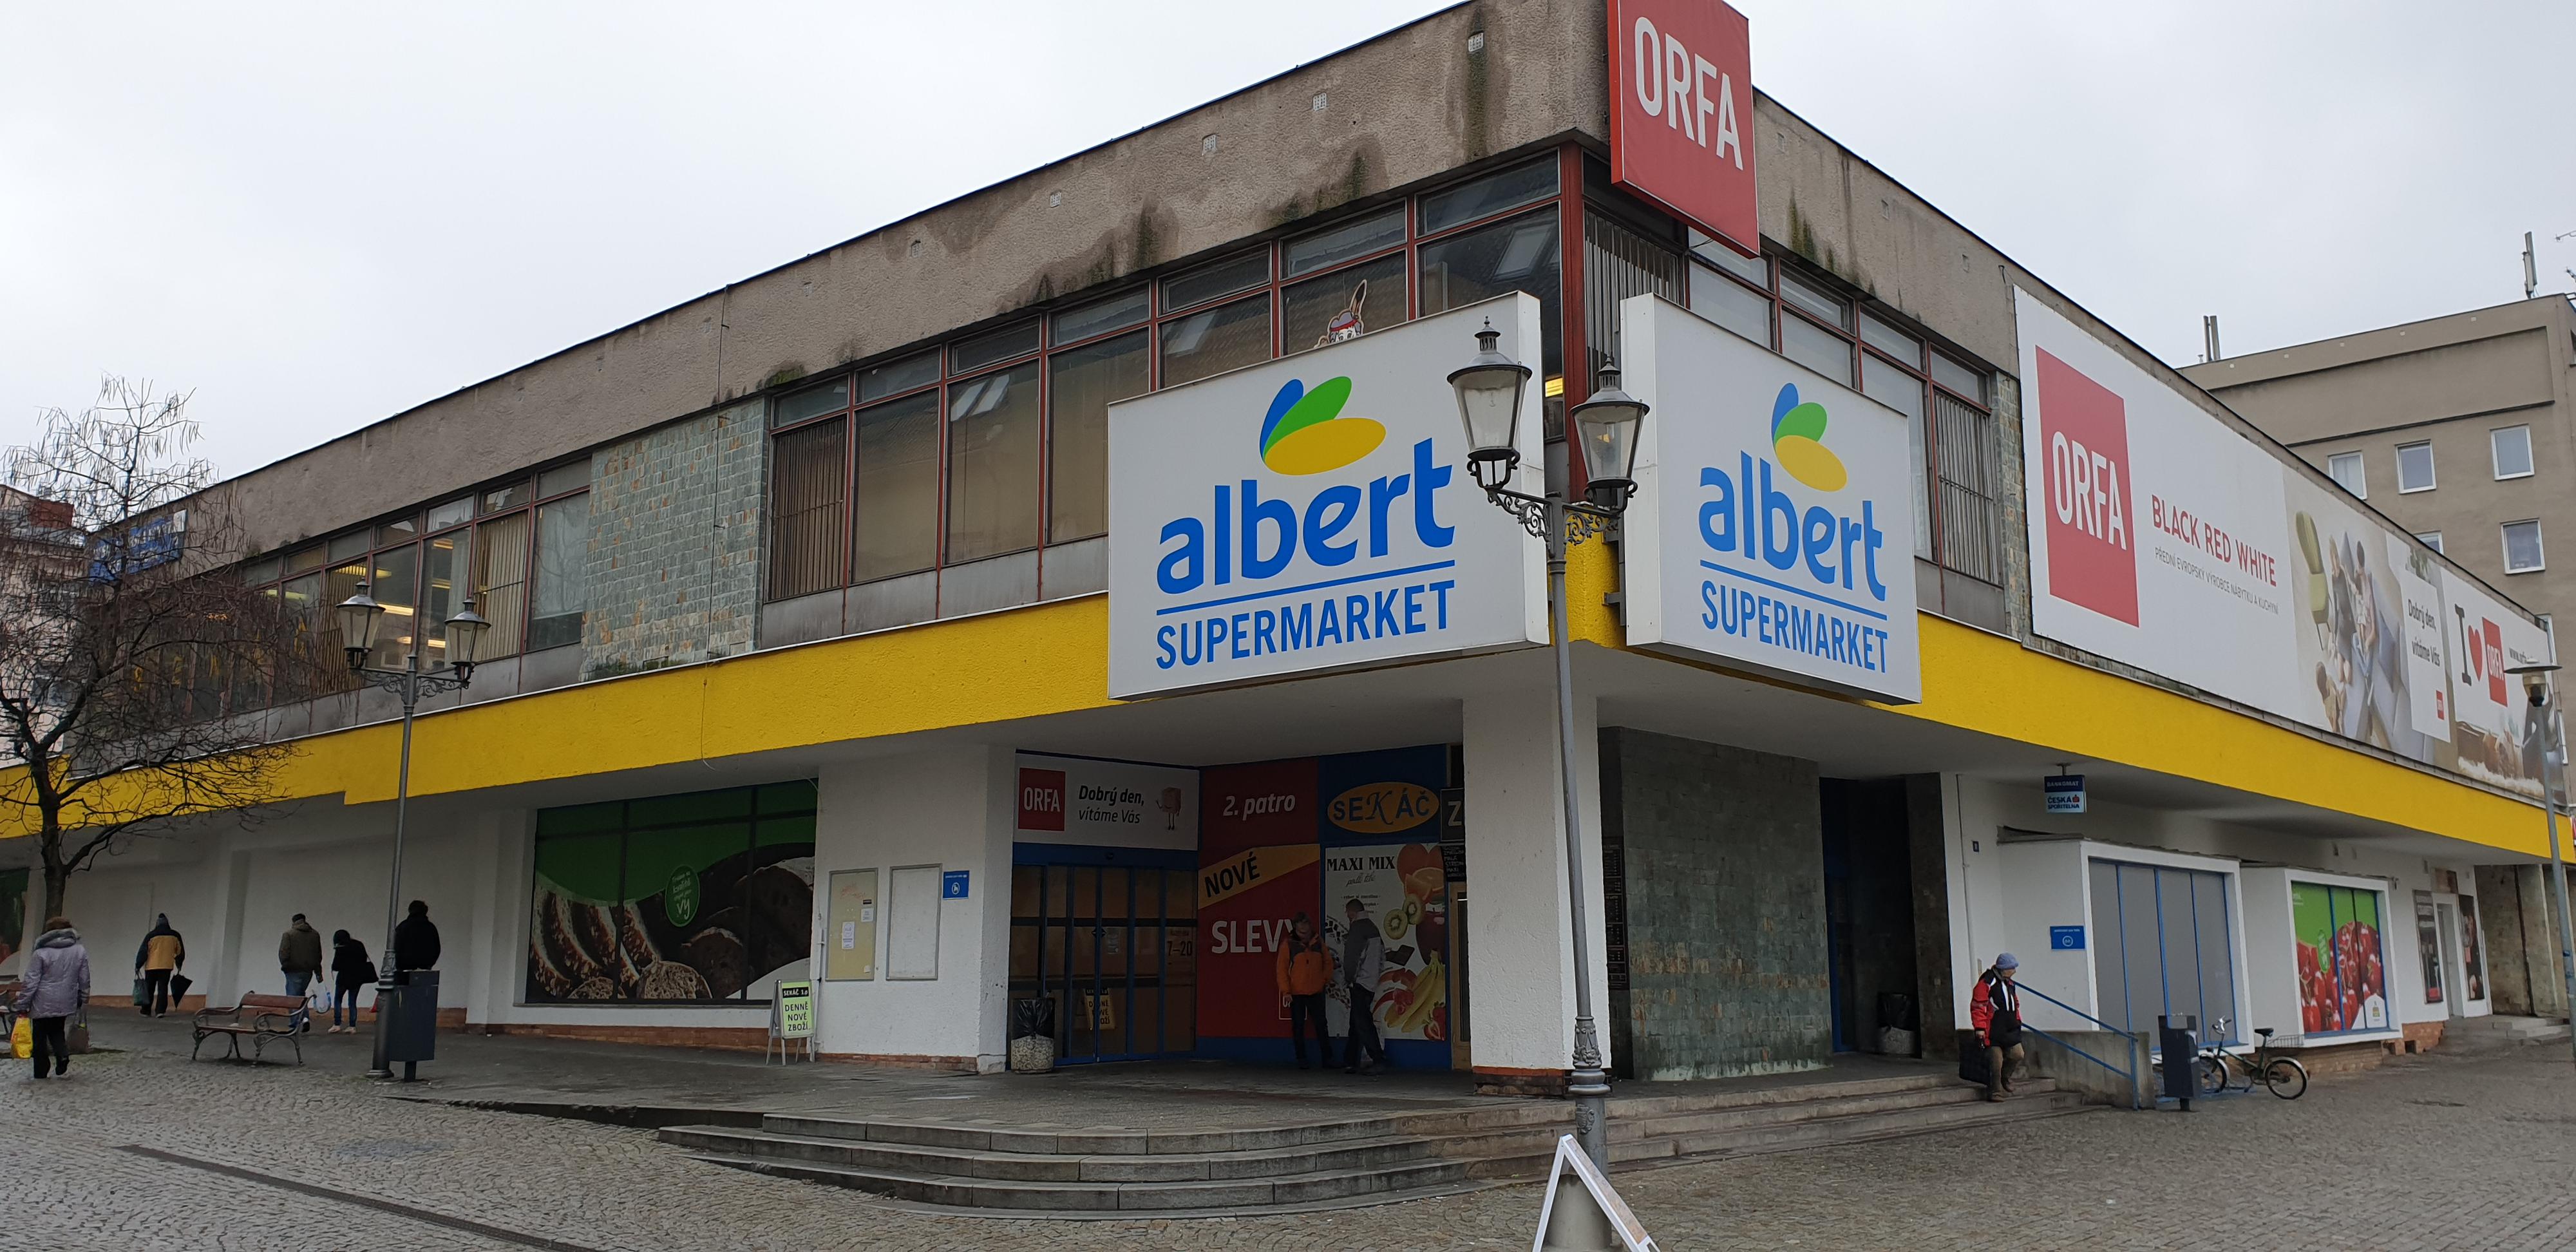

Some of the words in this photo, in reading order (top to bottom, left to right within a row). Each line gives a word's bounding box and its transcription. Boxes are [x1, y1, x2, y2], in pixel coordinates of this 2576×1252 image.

[1635, 17, 1743, 171] ORFA
[2052, 431, 2126, 551] ORFA
[1156, 437, 1455, 594] albert
[1699, 450, 1886, 602] albert
[2152, 494, 2201, 549] BLACK
[2204, 522, 2231, 563] RED
[2235, 539, 2277, 587] WHITE
[2155, 546, 2176, 567] PŘEDNÍ
[2177, 556, 2205, 580] EVROPSKÝ
[1155, 580, 1455, 670] SUPERMARKET
[1701, 580, 1888, 673] SUPERMARKET
[2408, 599, 2425, 629] Dobrý
[2425, 609, 2436, 632] den,
[2412, 636, 2430, 662] vítáme
[2430, 647, 2439, 667] Vás
[2454, 603, 2472, 687] I
[2487, 644, 2504, 680] ORFA
[1023, 786, 1060, 812] ORFA
[1078, 785, 1117, 806] Dobrý
[1119, 788, 1144, 806] den,
[1223, 795, 1239, 817] 2.
[1242, 793, 1296, 821] patro
[1333, 787, 1430, 826] SEKÁČ
[2047, 795, 2072, 804] ČESKÁ
[1079, 806, 1118, 822] vítáme
[1122, 809, 1140, 824] Vás
[1204, 849, 1260, 898] NOVÉ
[1327, 857, 1363, 871] MAXI
[1369, 855, 1396, 870] MIX
[1211, 918, 1293, 954] SLEV
[784, 1001, 808, 1012] DENNĚ
[788, 1011, 808, 1021] NOVÉ
[788, 1021, 808, 1031] ZBOŽÍ
